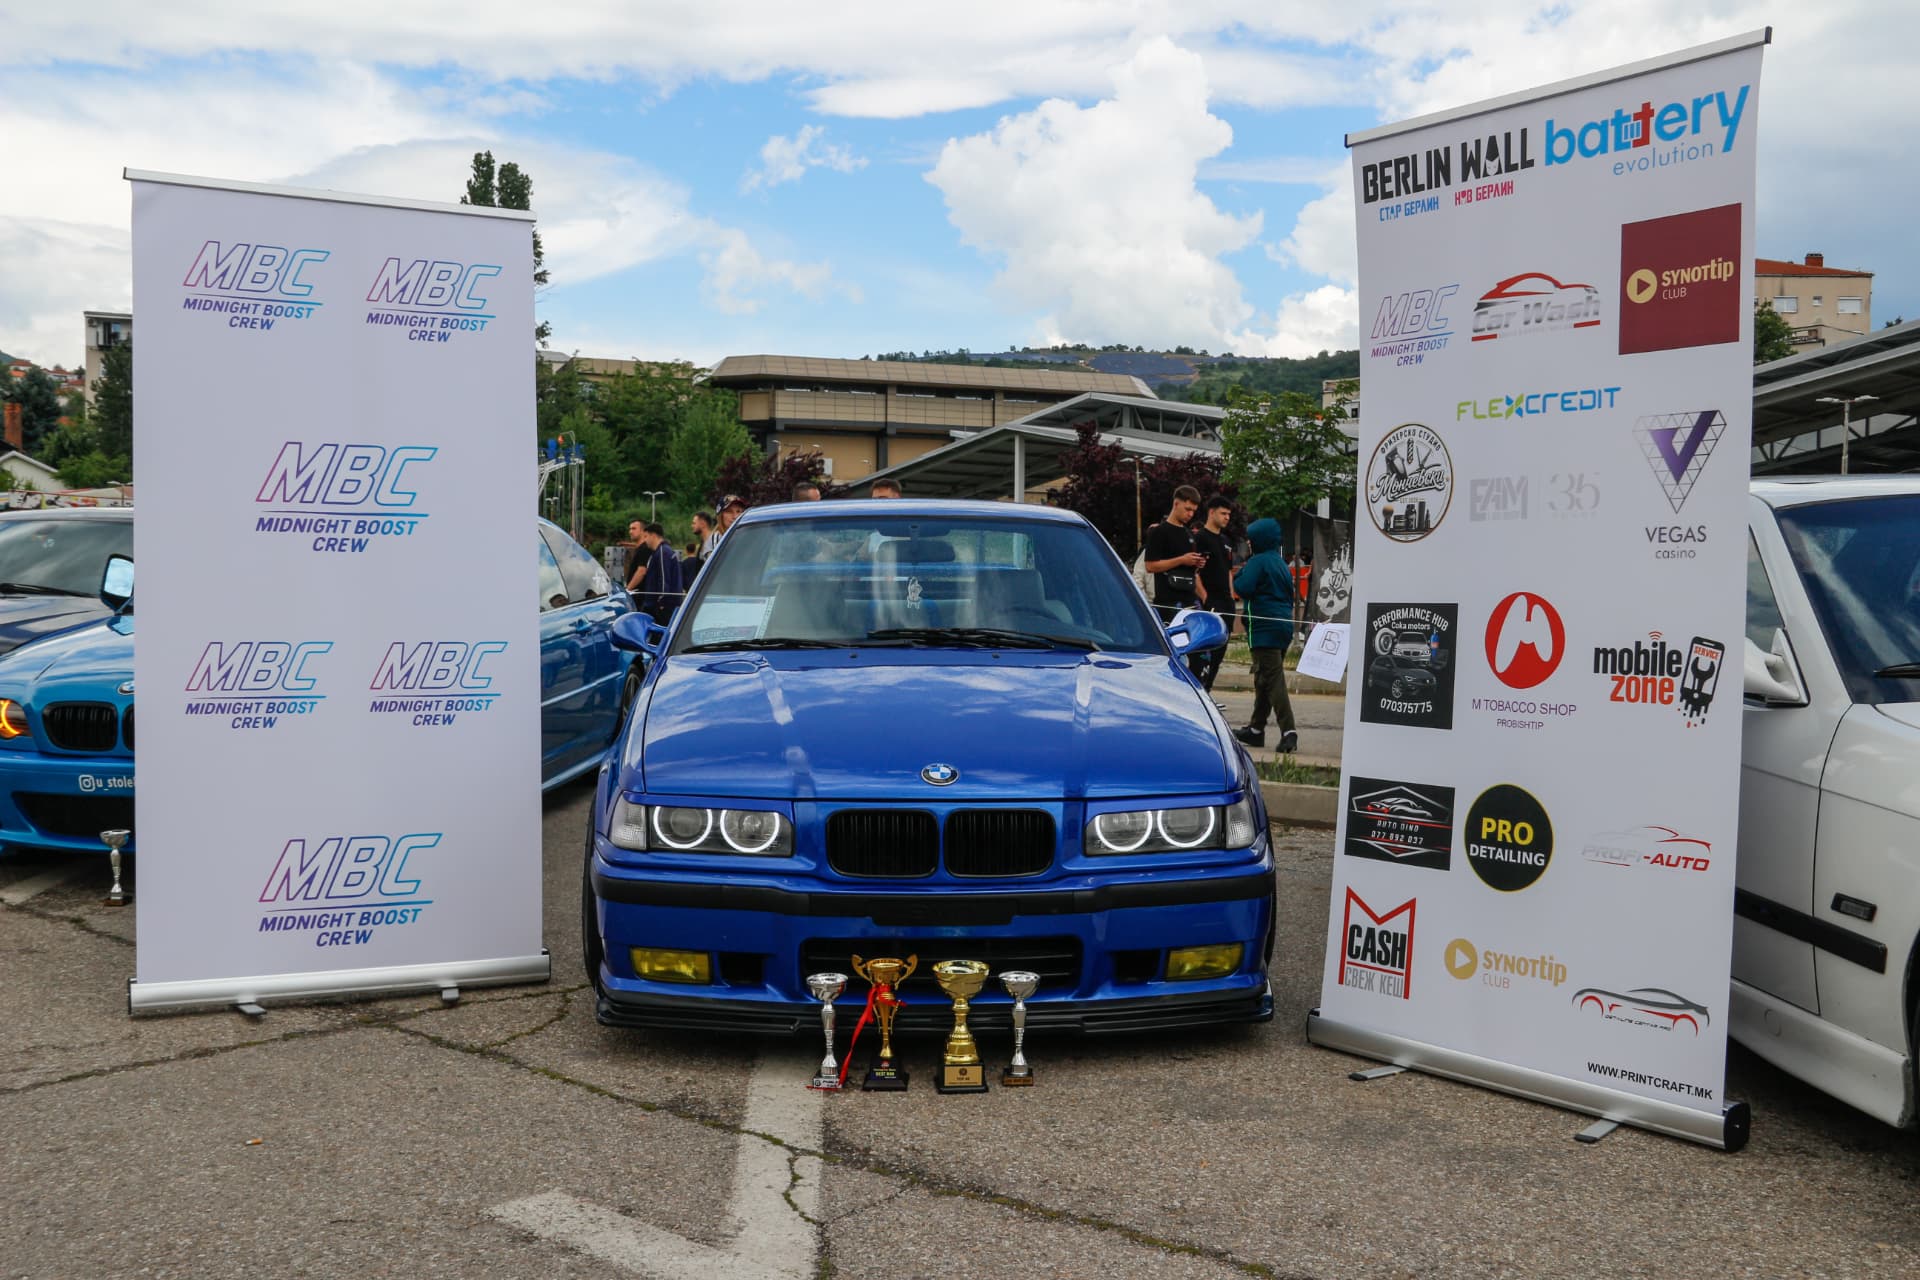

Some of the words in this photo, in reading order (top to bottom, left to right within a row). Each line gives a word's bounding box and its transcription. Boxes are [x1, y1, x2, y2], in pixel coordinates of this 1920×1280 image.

[1545, 85, 1751, 166] battery
[1362, 146, 1451, 203] BERLIN
[1461, 128, 1535, 183] WALL
[1613, 143, 1713, 176] evolution
[1476, 180, 1514, 202] БЕРЛИН
[1404, 196, 1439, 218] БЕРЛИН
[183, 240, 330, 296] MBC
[366, 257, 502, 309] MBC
[1662, 287, 1686, 300] CLUB
[183, 298, 261, 315] MIDNIGHT
[263, 304, 315, 319] BOOST
[1371, 284, 1460, 339] MBC
[229, 316, 274, 331] CREW
[366, 313, 437, 329] MIDNIGHT
[440, 318, 488, 332] BOOST
[408, 329, 451, 343] CREW
[1371, 342, 1415, 358] MIDNIGHT
[1417, 338, 1448, 354] BOOST
[1397, 354, 1424, 366] CREW
[256, 442, 438, 506] MBC
[255, 517, 351, 533] MIDNIGHT
[355, 519, 418, 535] BOOST
[1646, 525, 1707, 544] VEGAS
[313, 537, 368, 553] CREW
[1655, 546, 1696, 560] casino
[1373, 608, 1432, 631] PERFORMANCE
[1431, 613, 1449, 632] HUB
[1408, 623, 1431, 631] motors
[1594, 640, 1682, 677] mobile
[1694, 646, 1721, 660] SERVICE
[185, 641, 334, 691] MBC
[370, 641, 508, 690] MBC
[1610, 674, 1674, 704] zone
[185, 701, 262, 714] MIDNIGHT
[265, 700, 318, 713] BOOST
[370, 700, 442, 713] MIDNIGHT
[445, 699, 493, 711] BOOST
[1380, 698, 1433, 714] 070375775
[1472, 698, 1482, 712] M
[1483, 700, 1537, 714] TOBACCO
[1539, 702, 1577, 716] SHOP
[231, 717, 277, 729] CREW
[413, 714, 456, 726] CREW
[1497, 719, 1544, 729] PROBISHTIP
[1371, 830, 1386, 839] 077
[1377, 820, 1397, 829] AUTO
[1481, 818, 1534, 845] PRO
[1470, 845, 1545, 866] DETAILING
[258, 833, 442, 902] MBC
[259, 912, 356, 931] MIDNIGHT
[359, 908, 423, 926] BOOST
[316, 930, 373, 947] CREW
[1348, 925, 1407, 969] CASH
[1345, 967, 1376, 990] СВЕЖ
[1379, 974, 1405, 999] КЕШ
[1482, 973, 1510, 989] CLUB
[1587, 1062, 1712, 1100] WWW.PRINTCRAFT.MK
